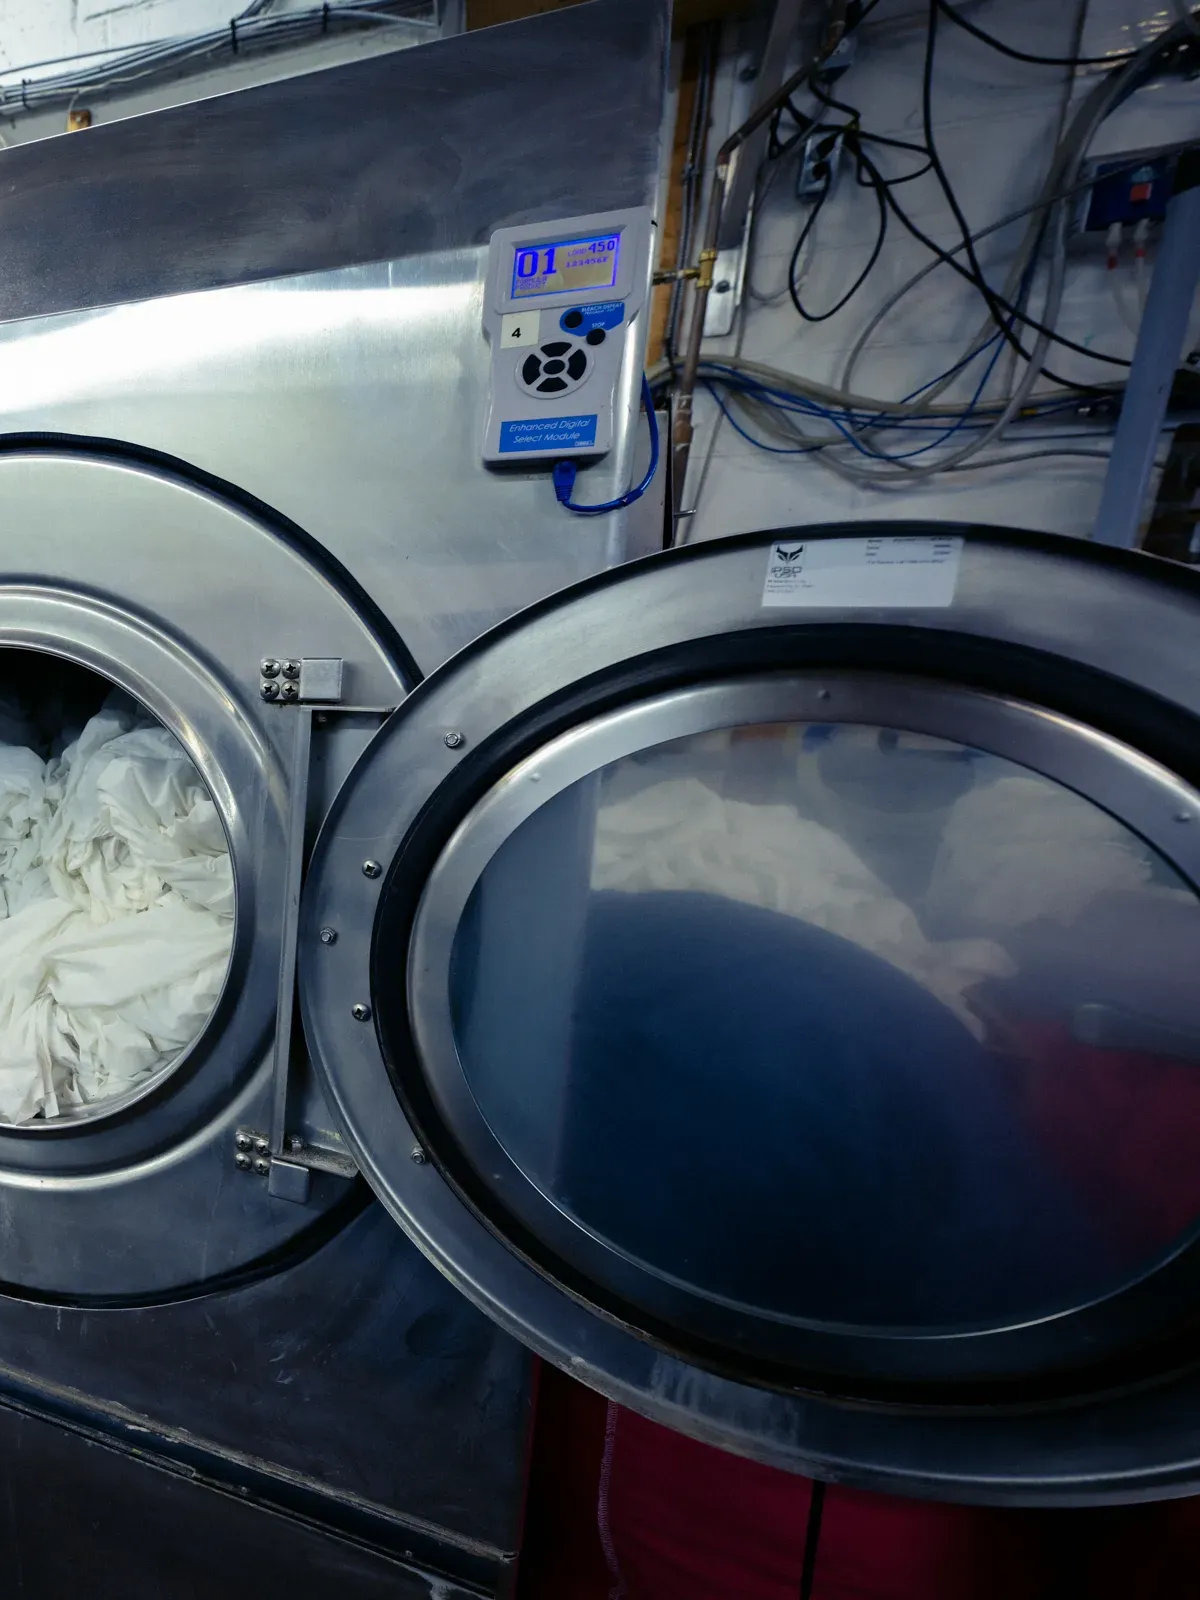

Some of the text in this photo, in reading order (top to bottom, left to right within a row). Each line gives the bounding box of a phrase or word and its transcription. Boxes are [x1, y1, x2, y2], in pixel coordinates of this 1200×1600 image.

[588, 240, 615, 253] 450
[517, 248, 557, 278] 01
[591, 321, 605, 329] STOP
[511, 327, 522, 338] 4
[508, 418, 591, 433] Enhanced Digital
[513, 431, 581, 444] Select Module
